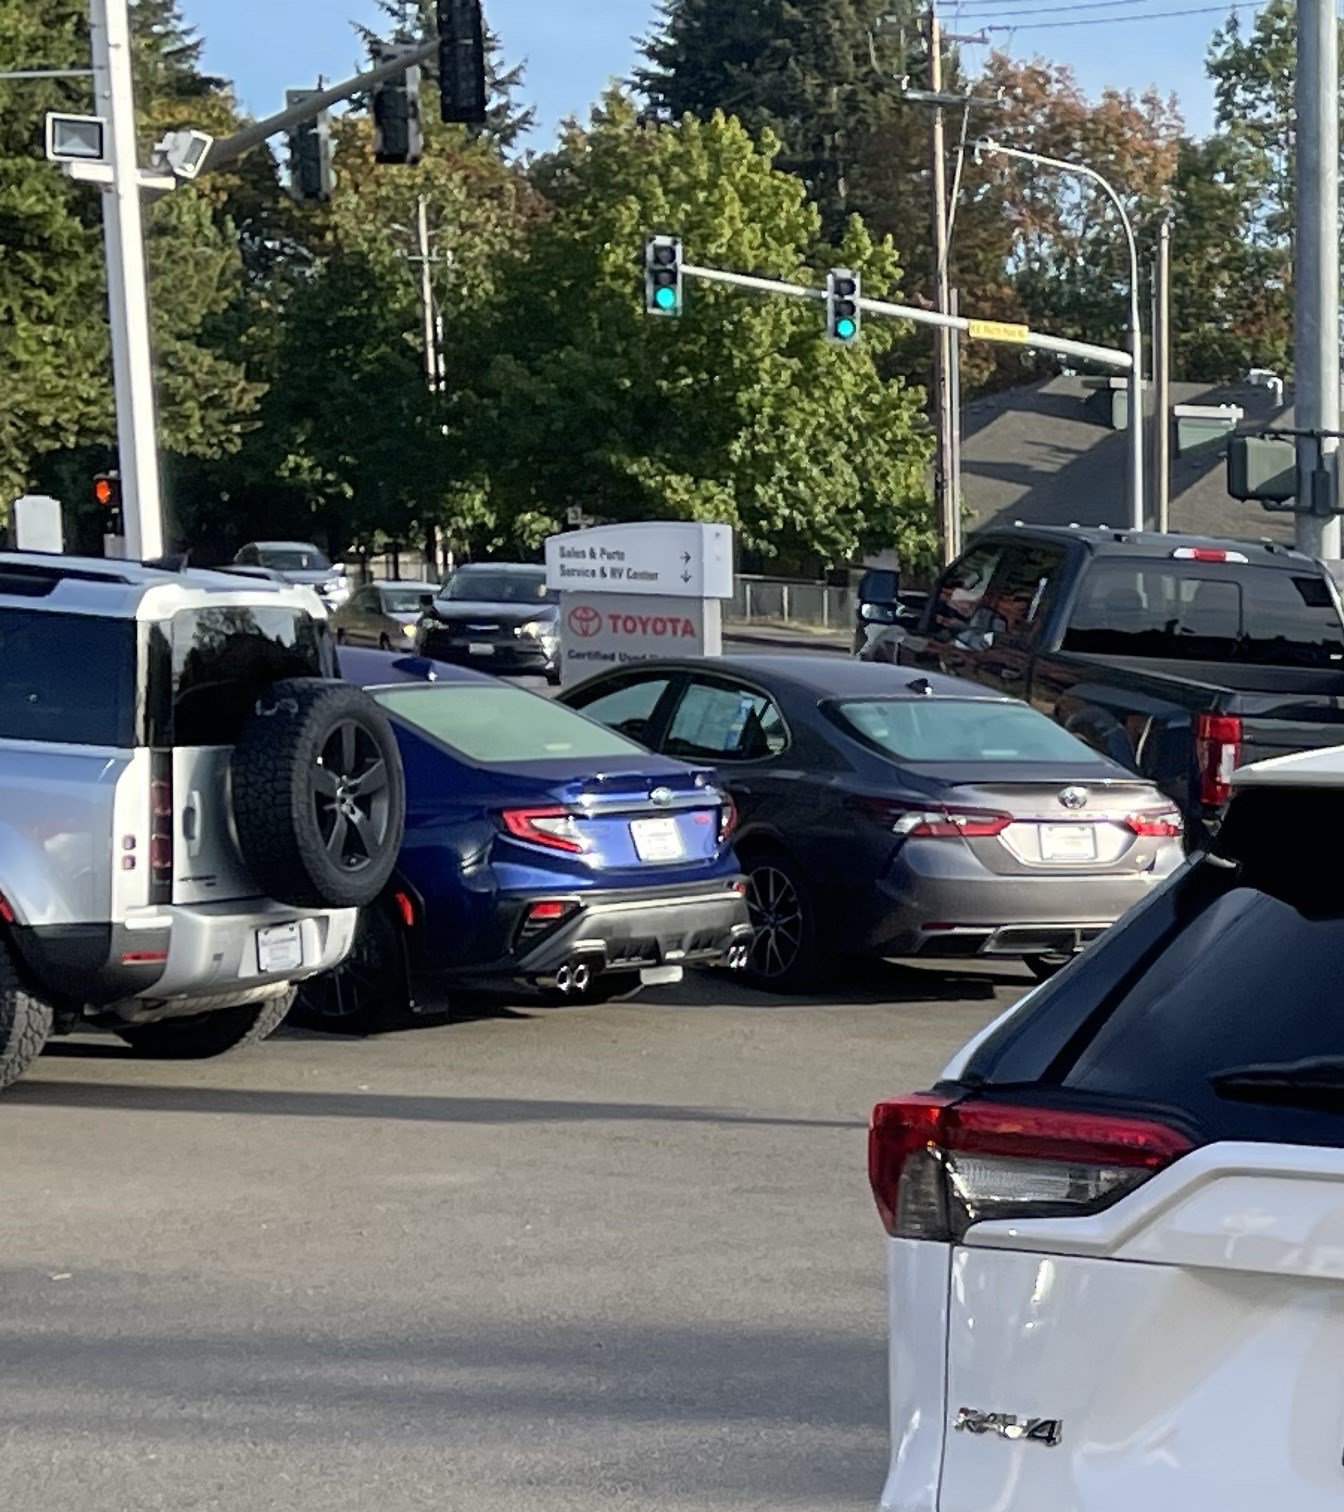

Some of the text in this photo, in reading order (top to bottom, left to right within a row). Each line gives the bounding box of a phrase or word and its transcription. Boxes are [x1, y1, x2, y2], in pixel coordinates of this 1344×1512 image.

[560, 546, 625, 561] Sales & Parts
[560, 564, 658, 580] Service & RV Center
[608, 614, 696, 637] TOYOTA
[567, 649, 615, 662] Certified
